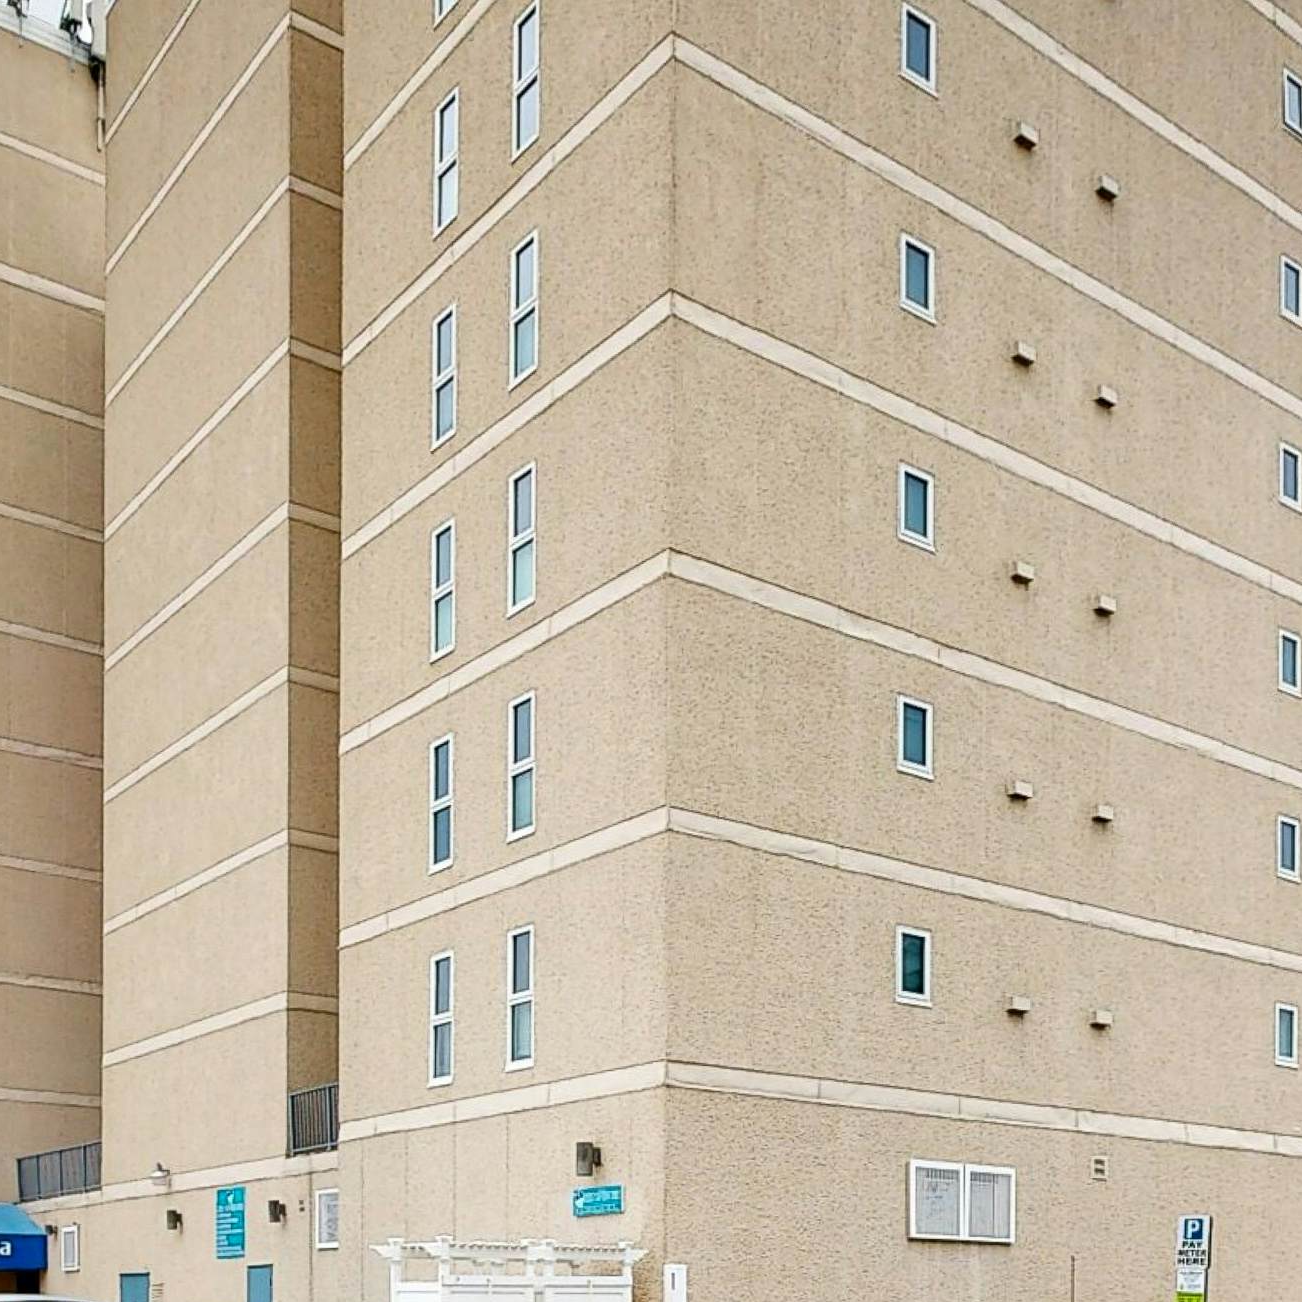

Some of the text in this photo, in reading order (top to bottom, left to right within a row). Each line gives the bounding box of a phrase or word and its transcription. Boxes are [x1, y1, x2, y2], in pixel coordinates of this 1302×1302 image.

[1187, 1220, 1199, 1239] P
[1177, 1249, 1206, 1257] METER
[1177, 1257, 1206, 1265] HERE
